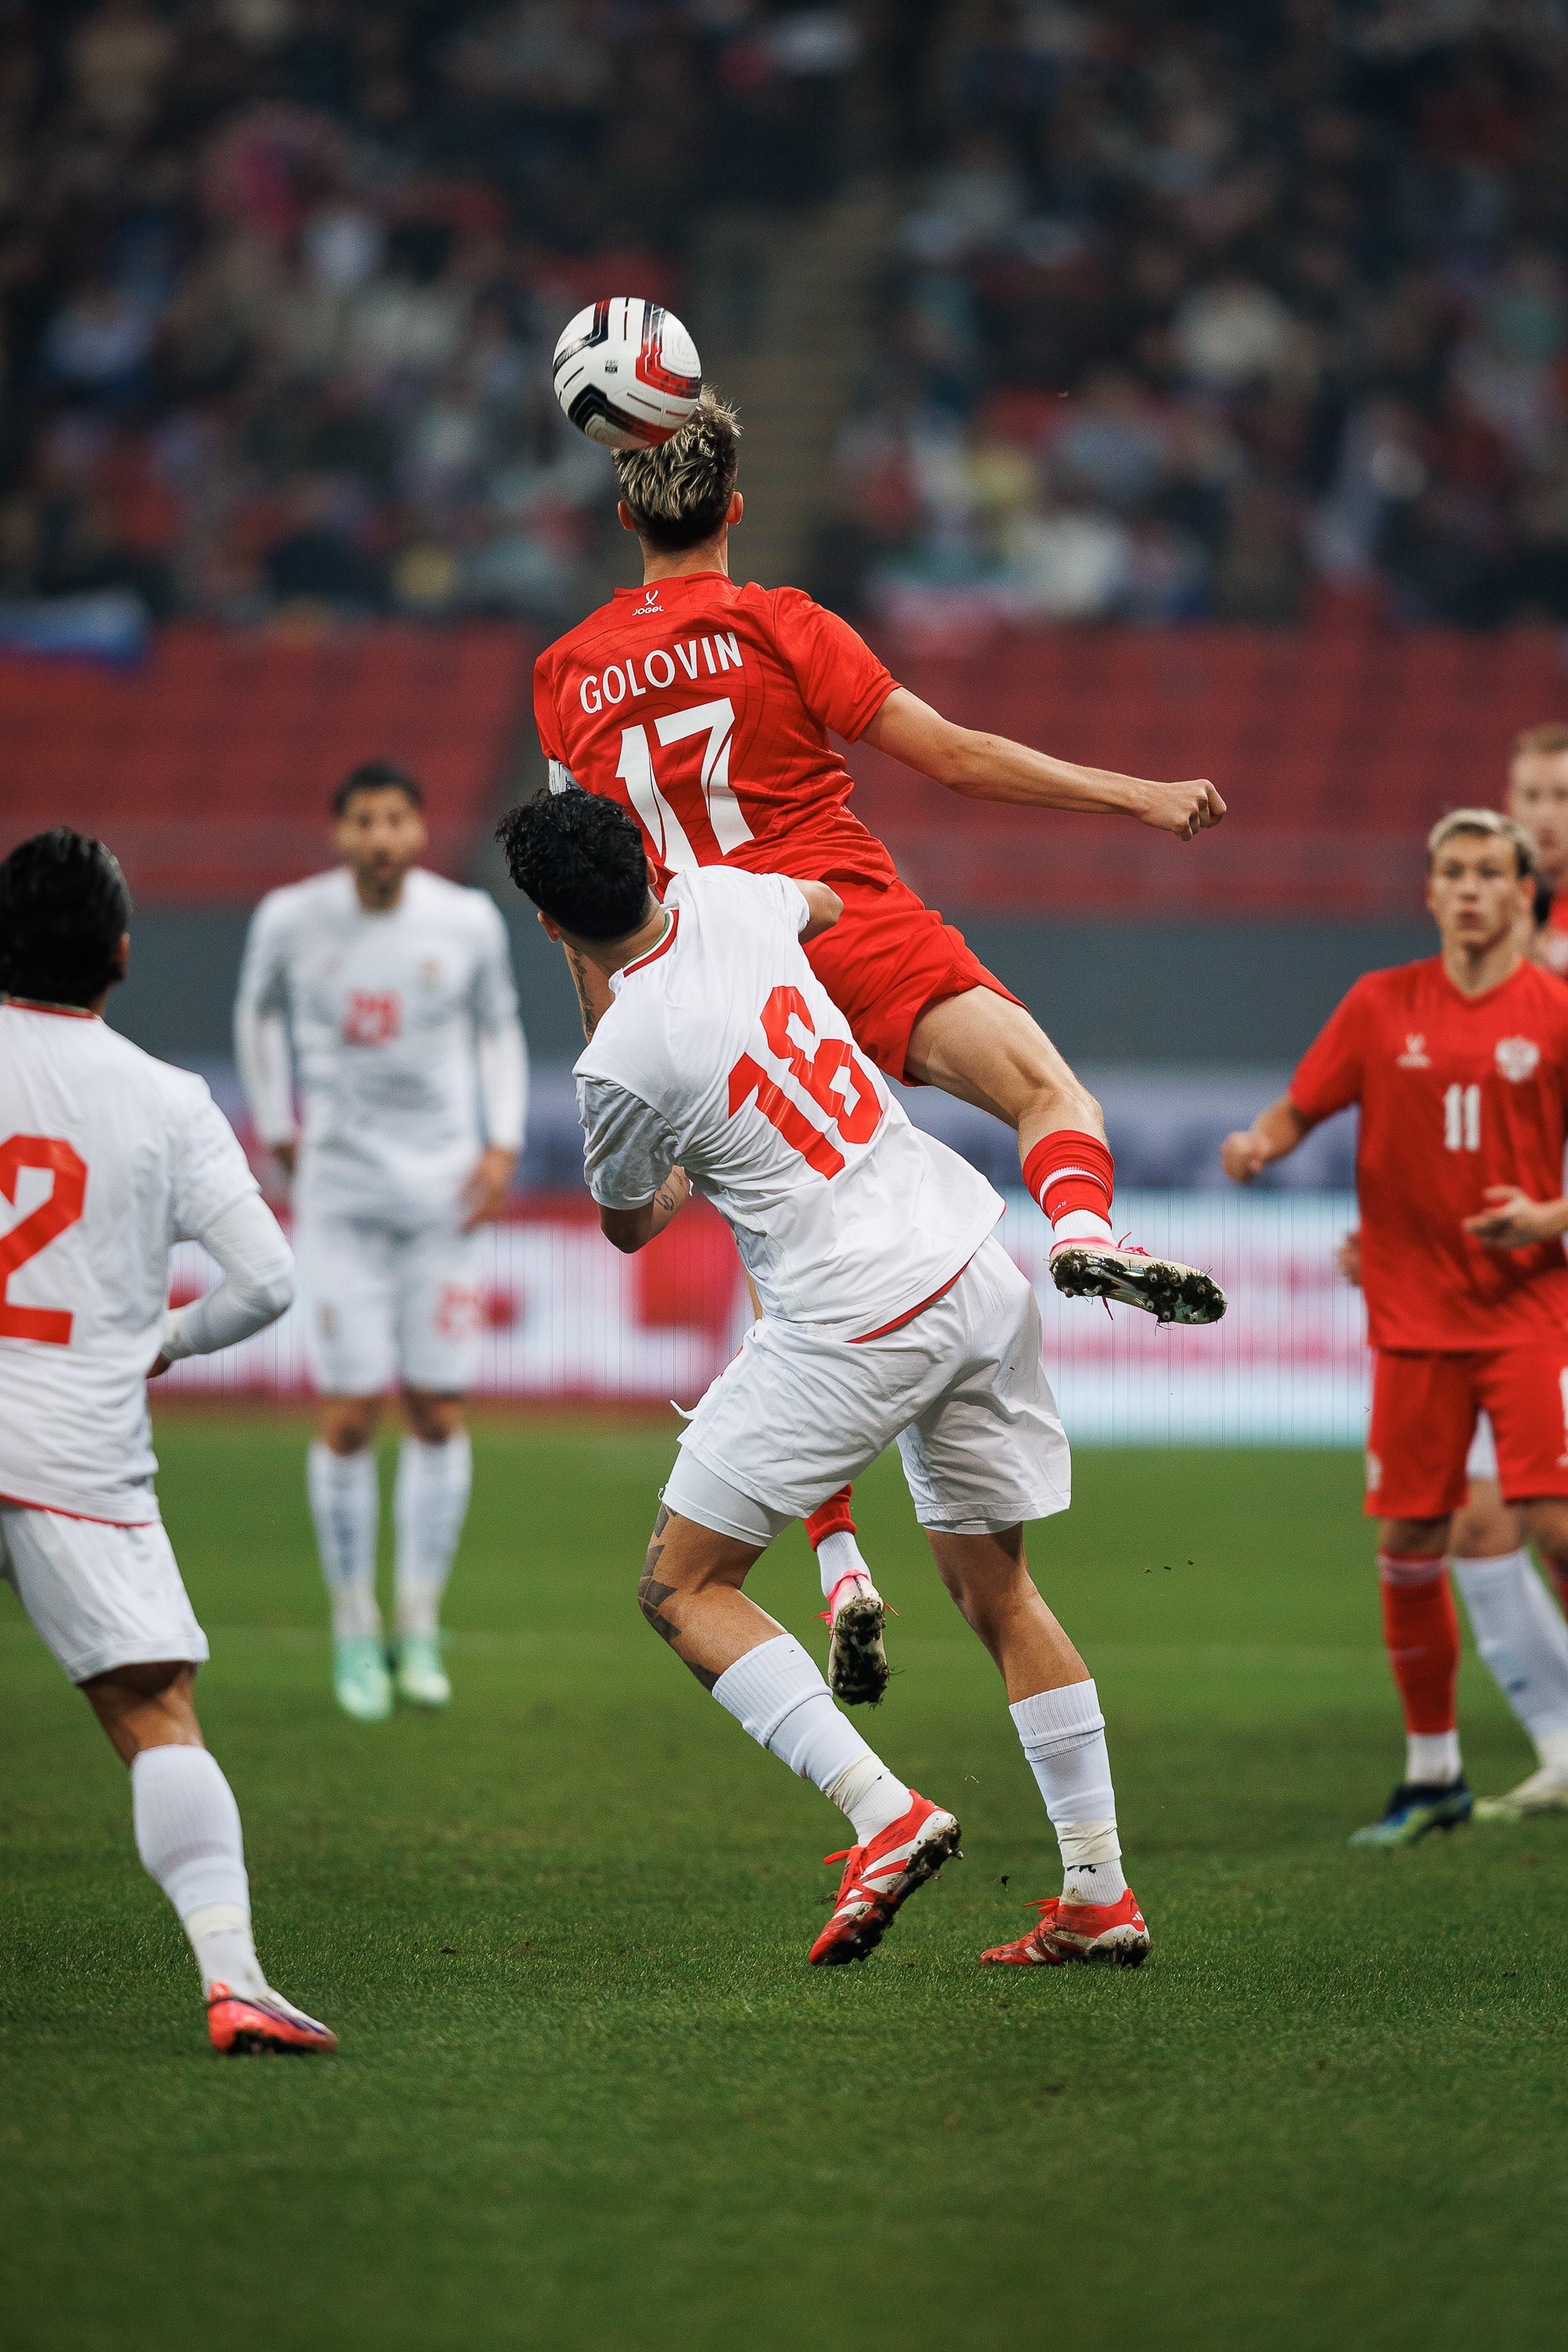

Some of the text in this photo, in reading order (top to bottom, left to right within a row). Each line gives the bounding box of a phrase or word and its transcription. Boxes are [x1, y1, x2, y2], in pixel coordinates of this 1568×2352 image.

[579, 632, 743, 714] GOLOVIN
[615, 697, 755, 873] 17
[728, 985, 884, 1180] 16
[1443, 1083, 1481, 1151] 11
[0, 1133, 88, 1346] 2
